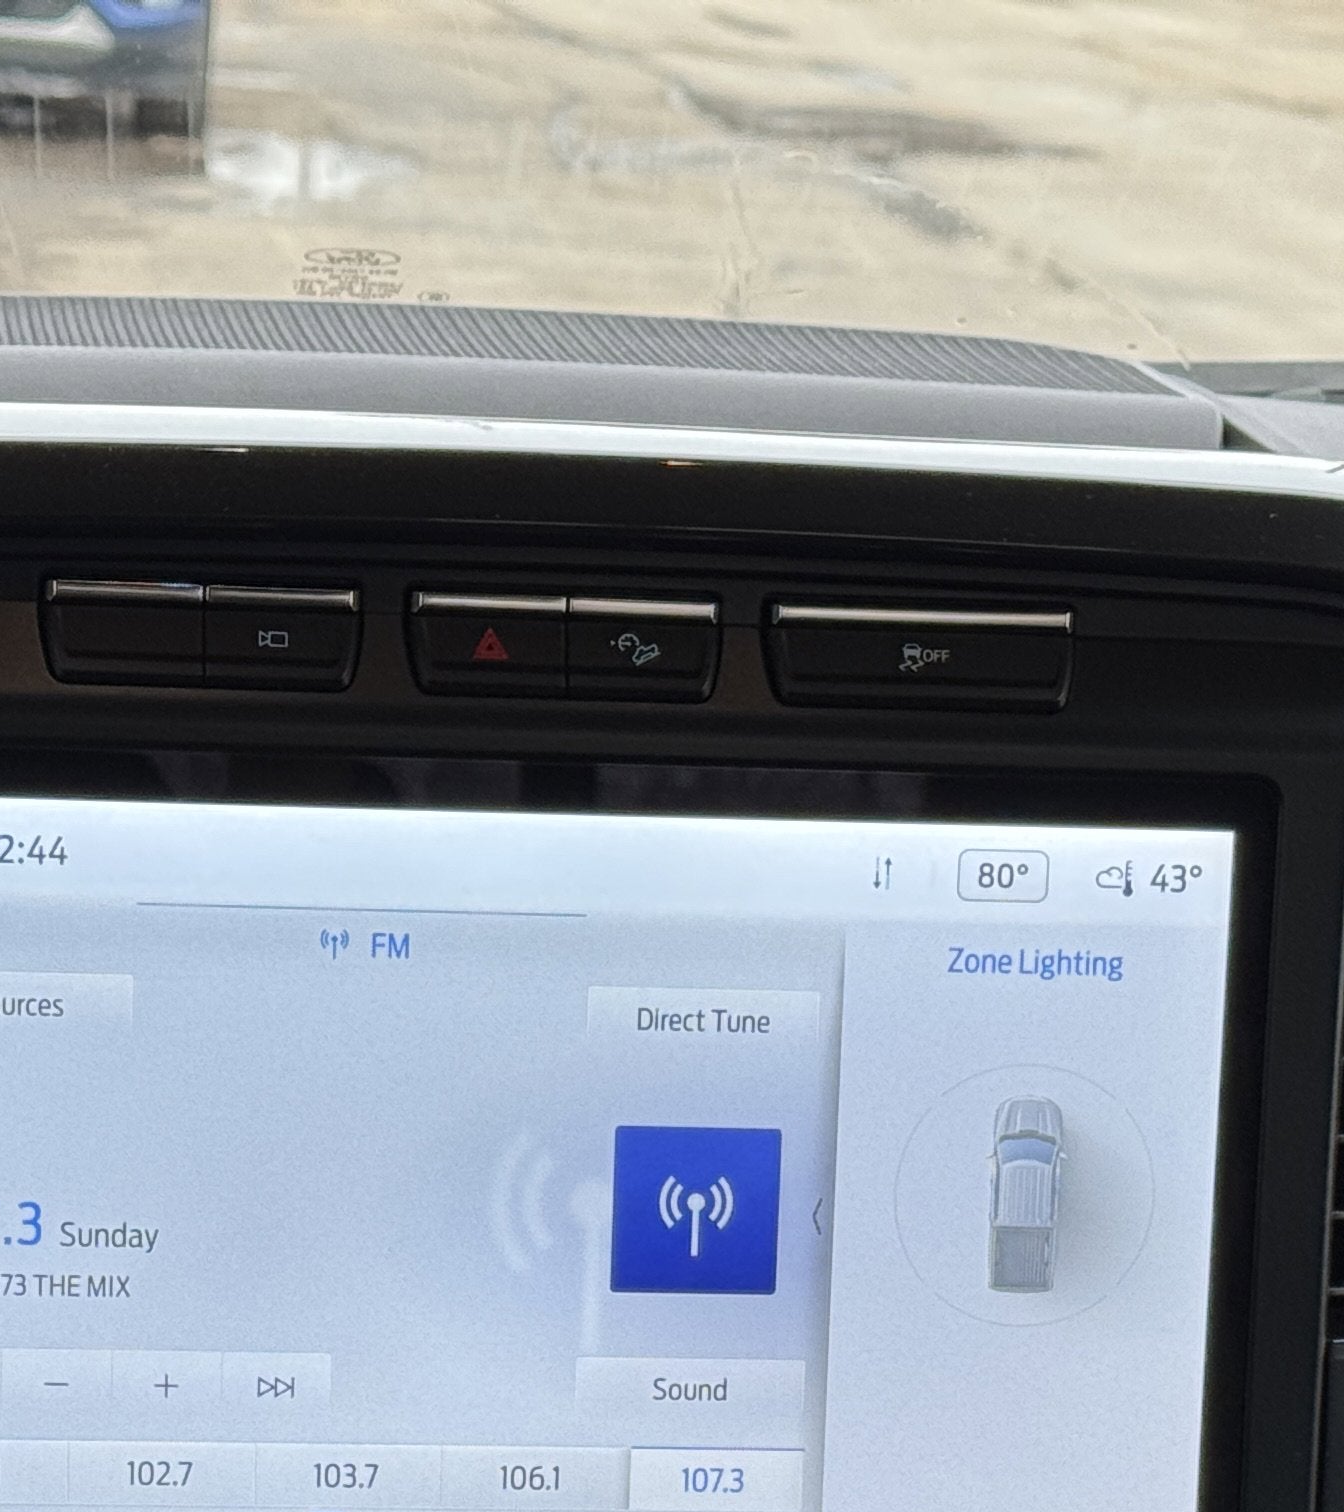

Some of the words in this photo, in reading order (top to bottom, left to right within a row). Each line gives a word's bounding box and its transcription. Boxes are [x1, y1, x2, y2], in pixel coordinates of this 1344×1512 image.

[921, 648, 951, 664] OFF
[977, 862, 1029, 890] 80°
[1150, 864, 1203, 893] 43°
[371, 933, 411, 959] FM
[947, 946, 1012, 975] Zone
[1019, 949, 1124, 982] Lighting
[636, 1007, 705, 1033] Direct
[710, 1009, 771, 1034] Tune
[59, 1221, 159, 1254] Sunday
[33, 1275, 80, 1298] THE
[86, 1276, 130, 1298] MIX
[652, 1377, 728, 1402] Sound
[127, 1461, 193, 1487] 102.7
[313, 1464, 379, 1489] 103.7
[499, 1466, 560, 1491] 106.1
[681, 1468, 745, 1494] 107.3
